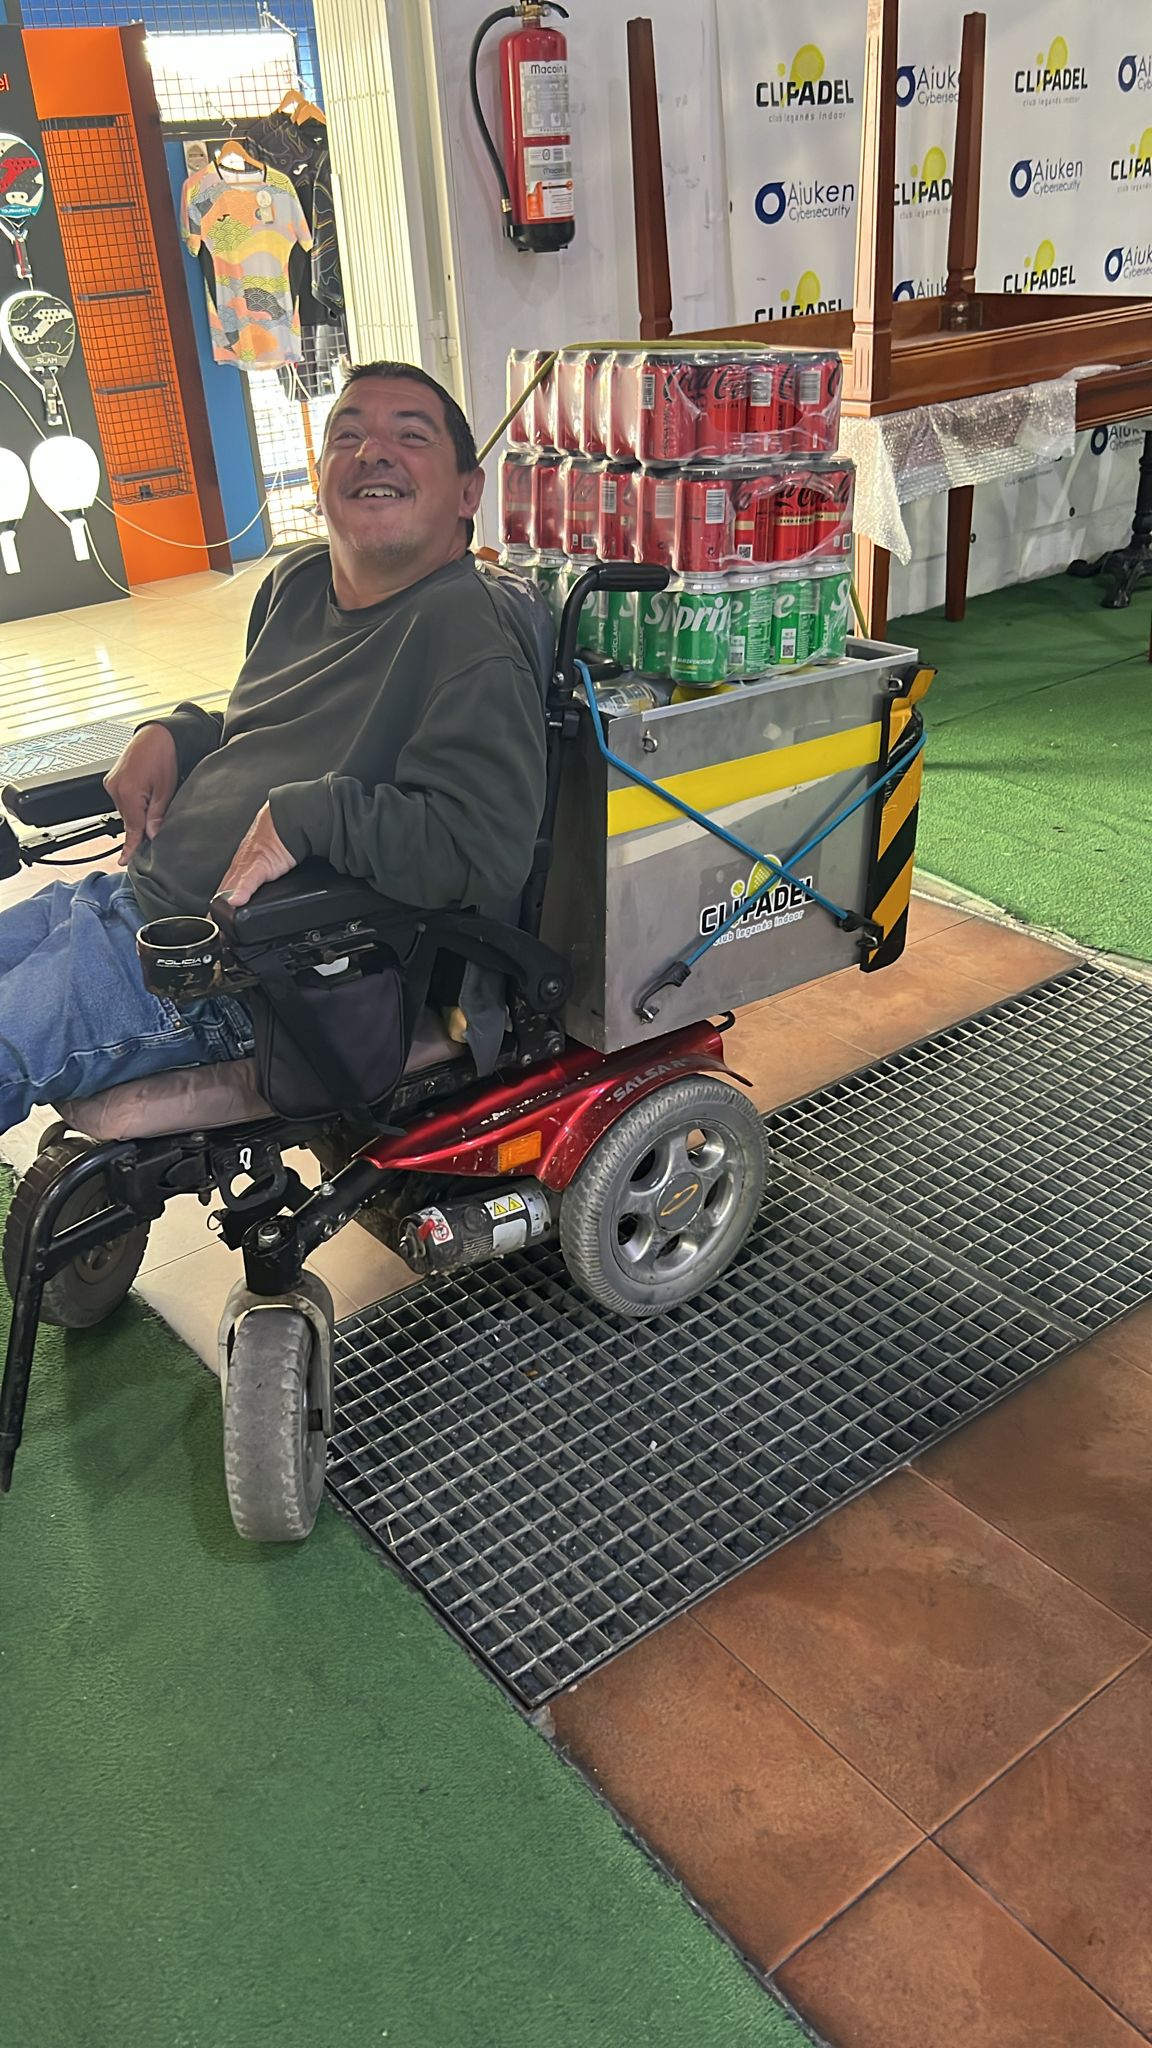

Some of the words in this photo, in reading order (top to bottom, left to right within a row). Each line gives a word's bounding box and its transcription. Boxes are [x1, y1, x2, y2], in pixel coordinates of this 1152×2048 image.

[917, 65, 961, 91] Aiuk
[1014, 67, 1088, 93] CLIPADEL
[756, 79, 854, 107] CLIPADEL
[818, 110, 847, 121] indoor
[1033, 157, 1083, 182] Aiuken
[787, 180, 855, 207] Aiuken
[1033, 180, 1081, 196] Cybersecurity
[788, 203, 851, 224] Cybersecurity
[1003, 264, 1076, 294] CLIPADEL
[36, 357, 58, 365] SLAM
[700, 876, 817, 936] CLIPADEL
[736, 919, 773, 940] leganés
[774, 909, 805, 928] indoor
[613, 1064, 672, 1102] SALSA
